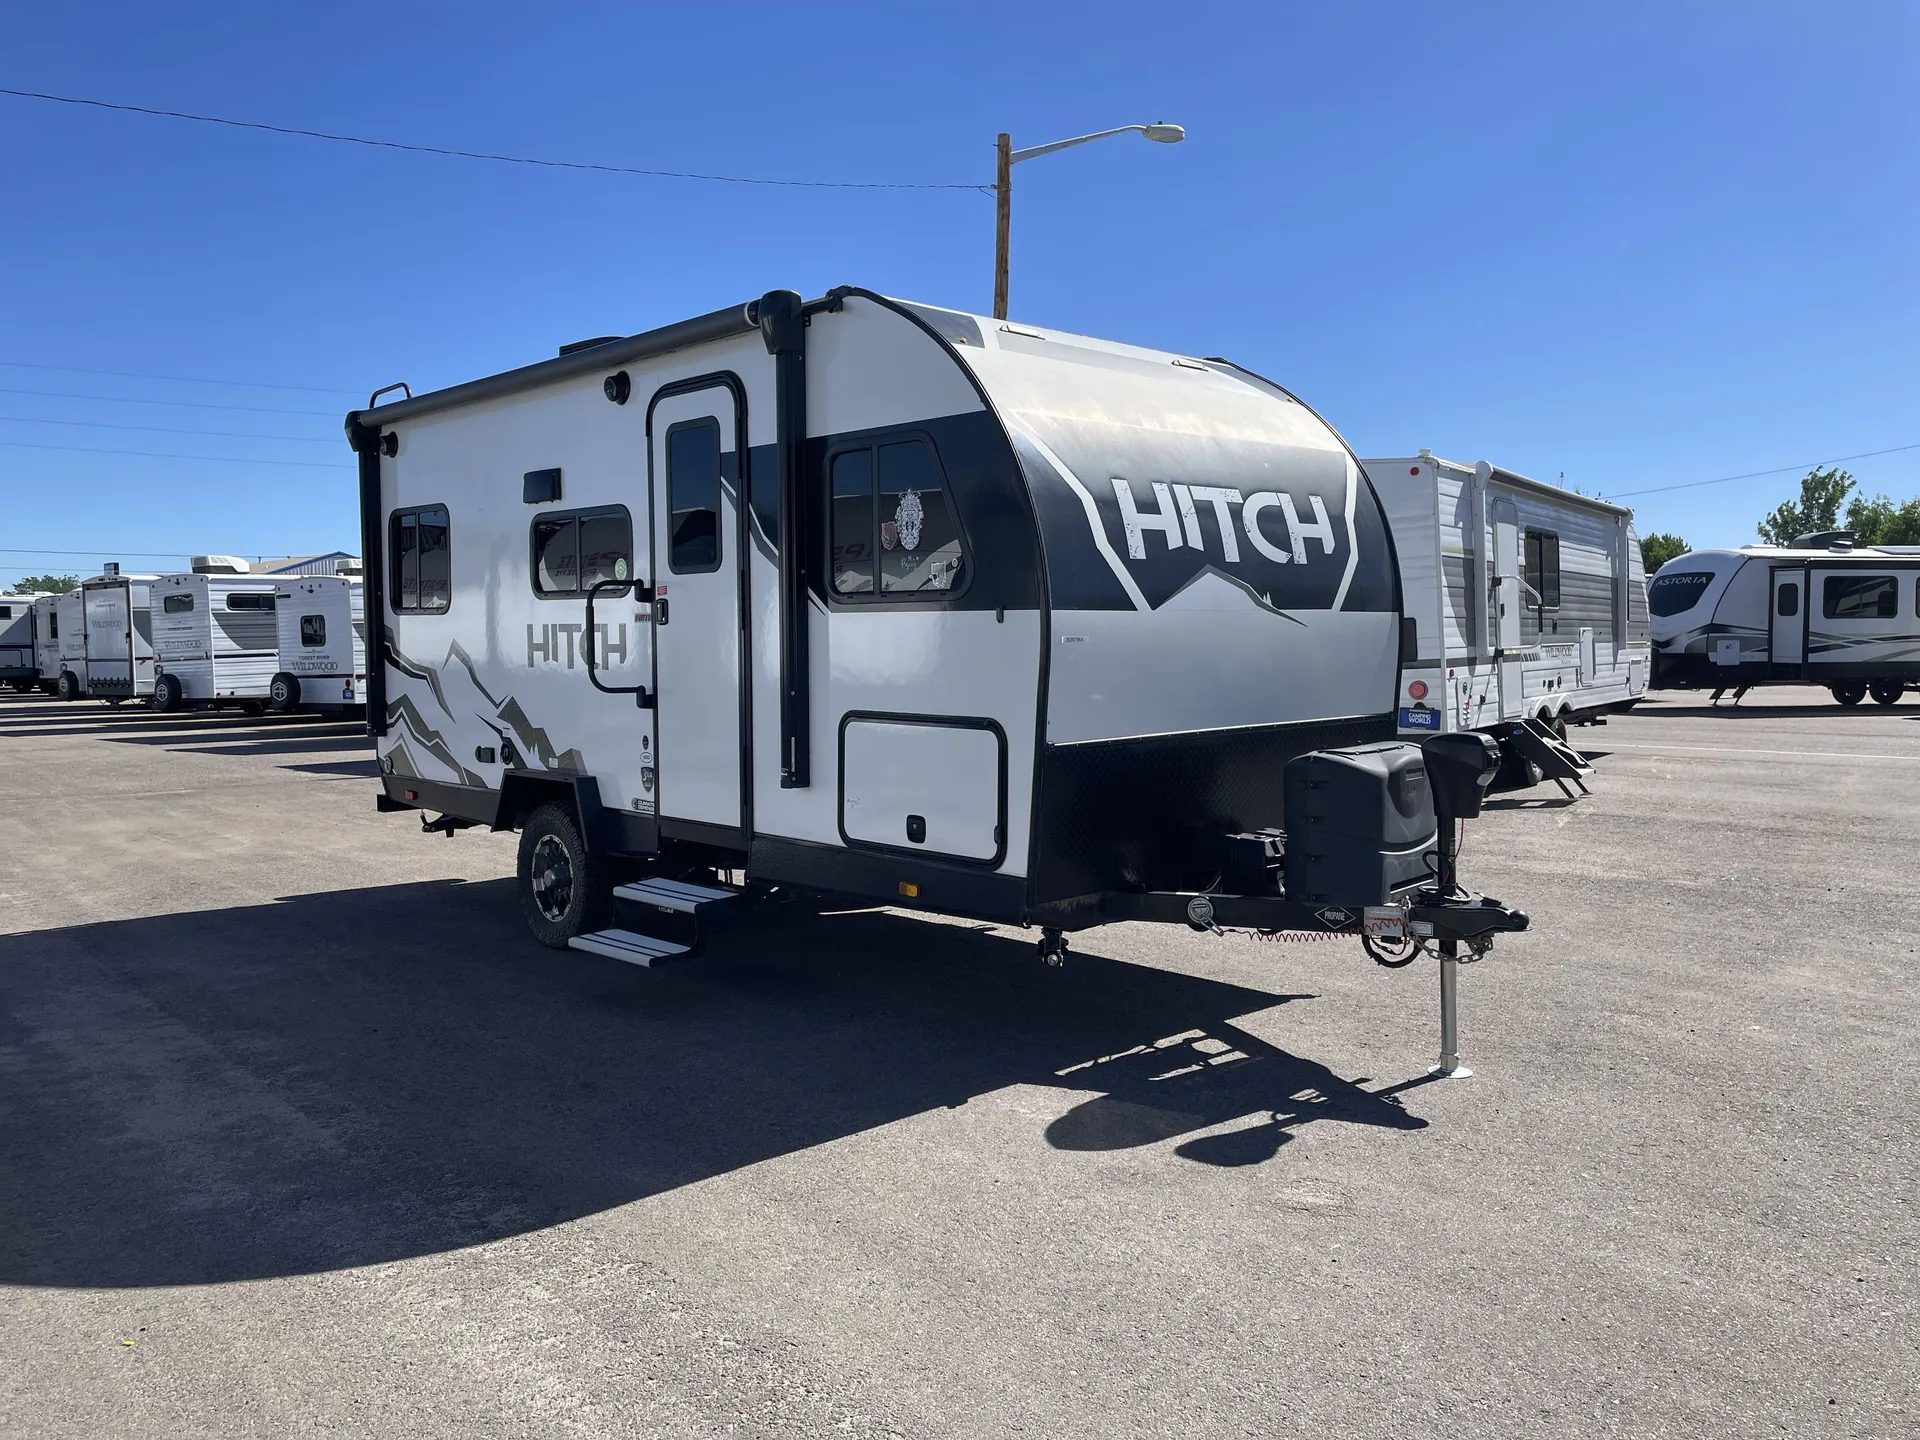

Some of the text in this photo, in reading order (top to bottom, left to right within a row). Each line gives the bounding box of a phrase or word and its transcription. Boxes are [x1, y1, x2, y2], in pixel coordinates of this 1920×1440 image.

[1110, 478, 1335, 565] HITCH
[1655, 576, 1707, 587] ASTORIA
[526, 623, 627, 670] HITCH
[292, 661, 339, 671] WILDWOOD
[1409, 717, 1432, 725] WORLD
[1324, 911, 1346, 921] PROPANE
